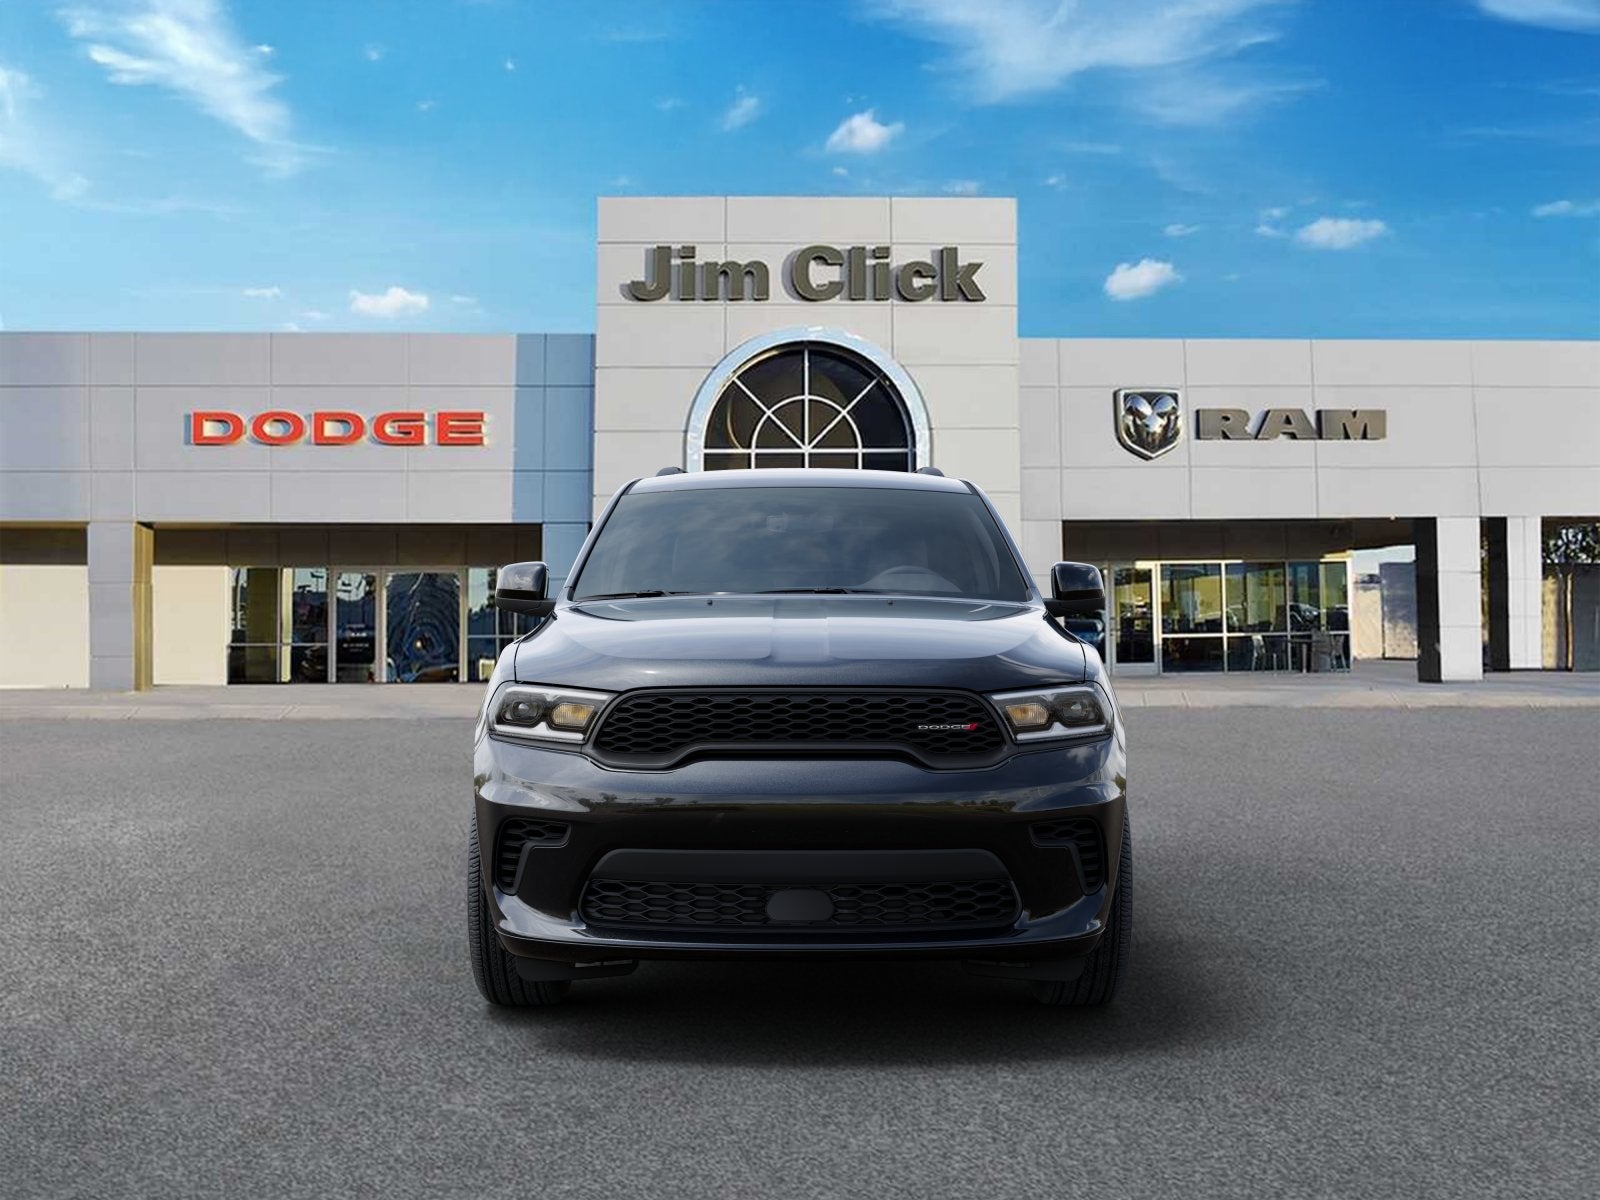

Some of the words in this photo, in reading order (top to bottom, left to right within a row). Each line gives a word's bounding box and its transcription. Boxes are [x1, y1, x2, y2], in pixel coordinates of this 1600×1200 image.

[629, 245, 770, 302] Jim
[789, 245, 987, 302] Click
[190, 410, 487, 447] DODGE
[1195, 408, 1388, 441] RAM
